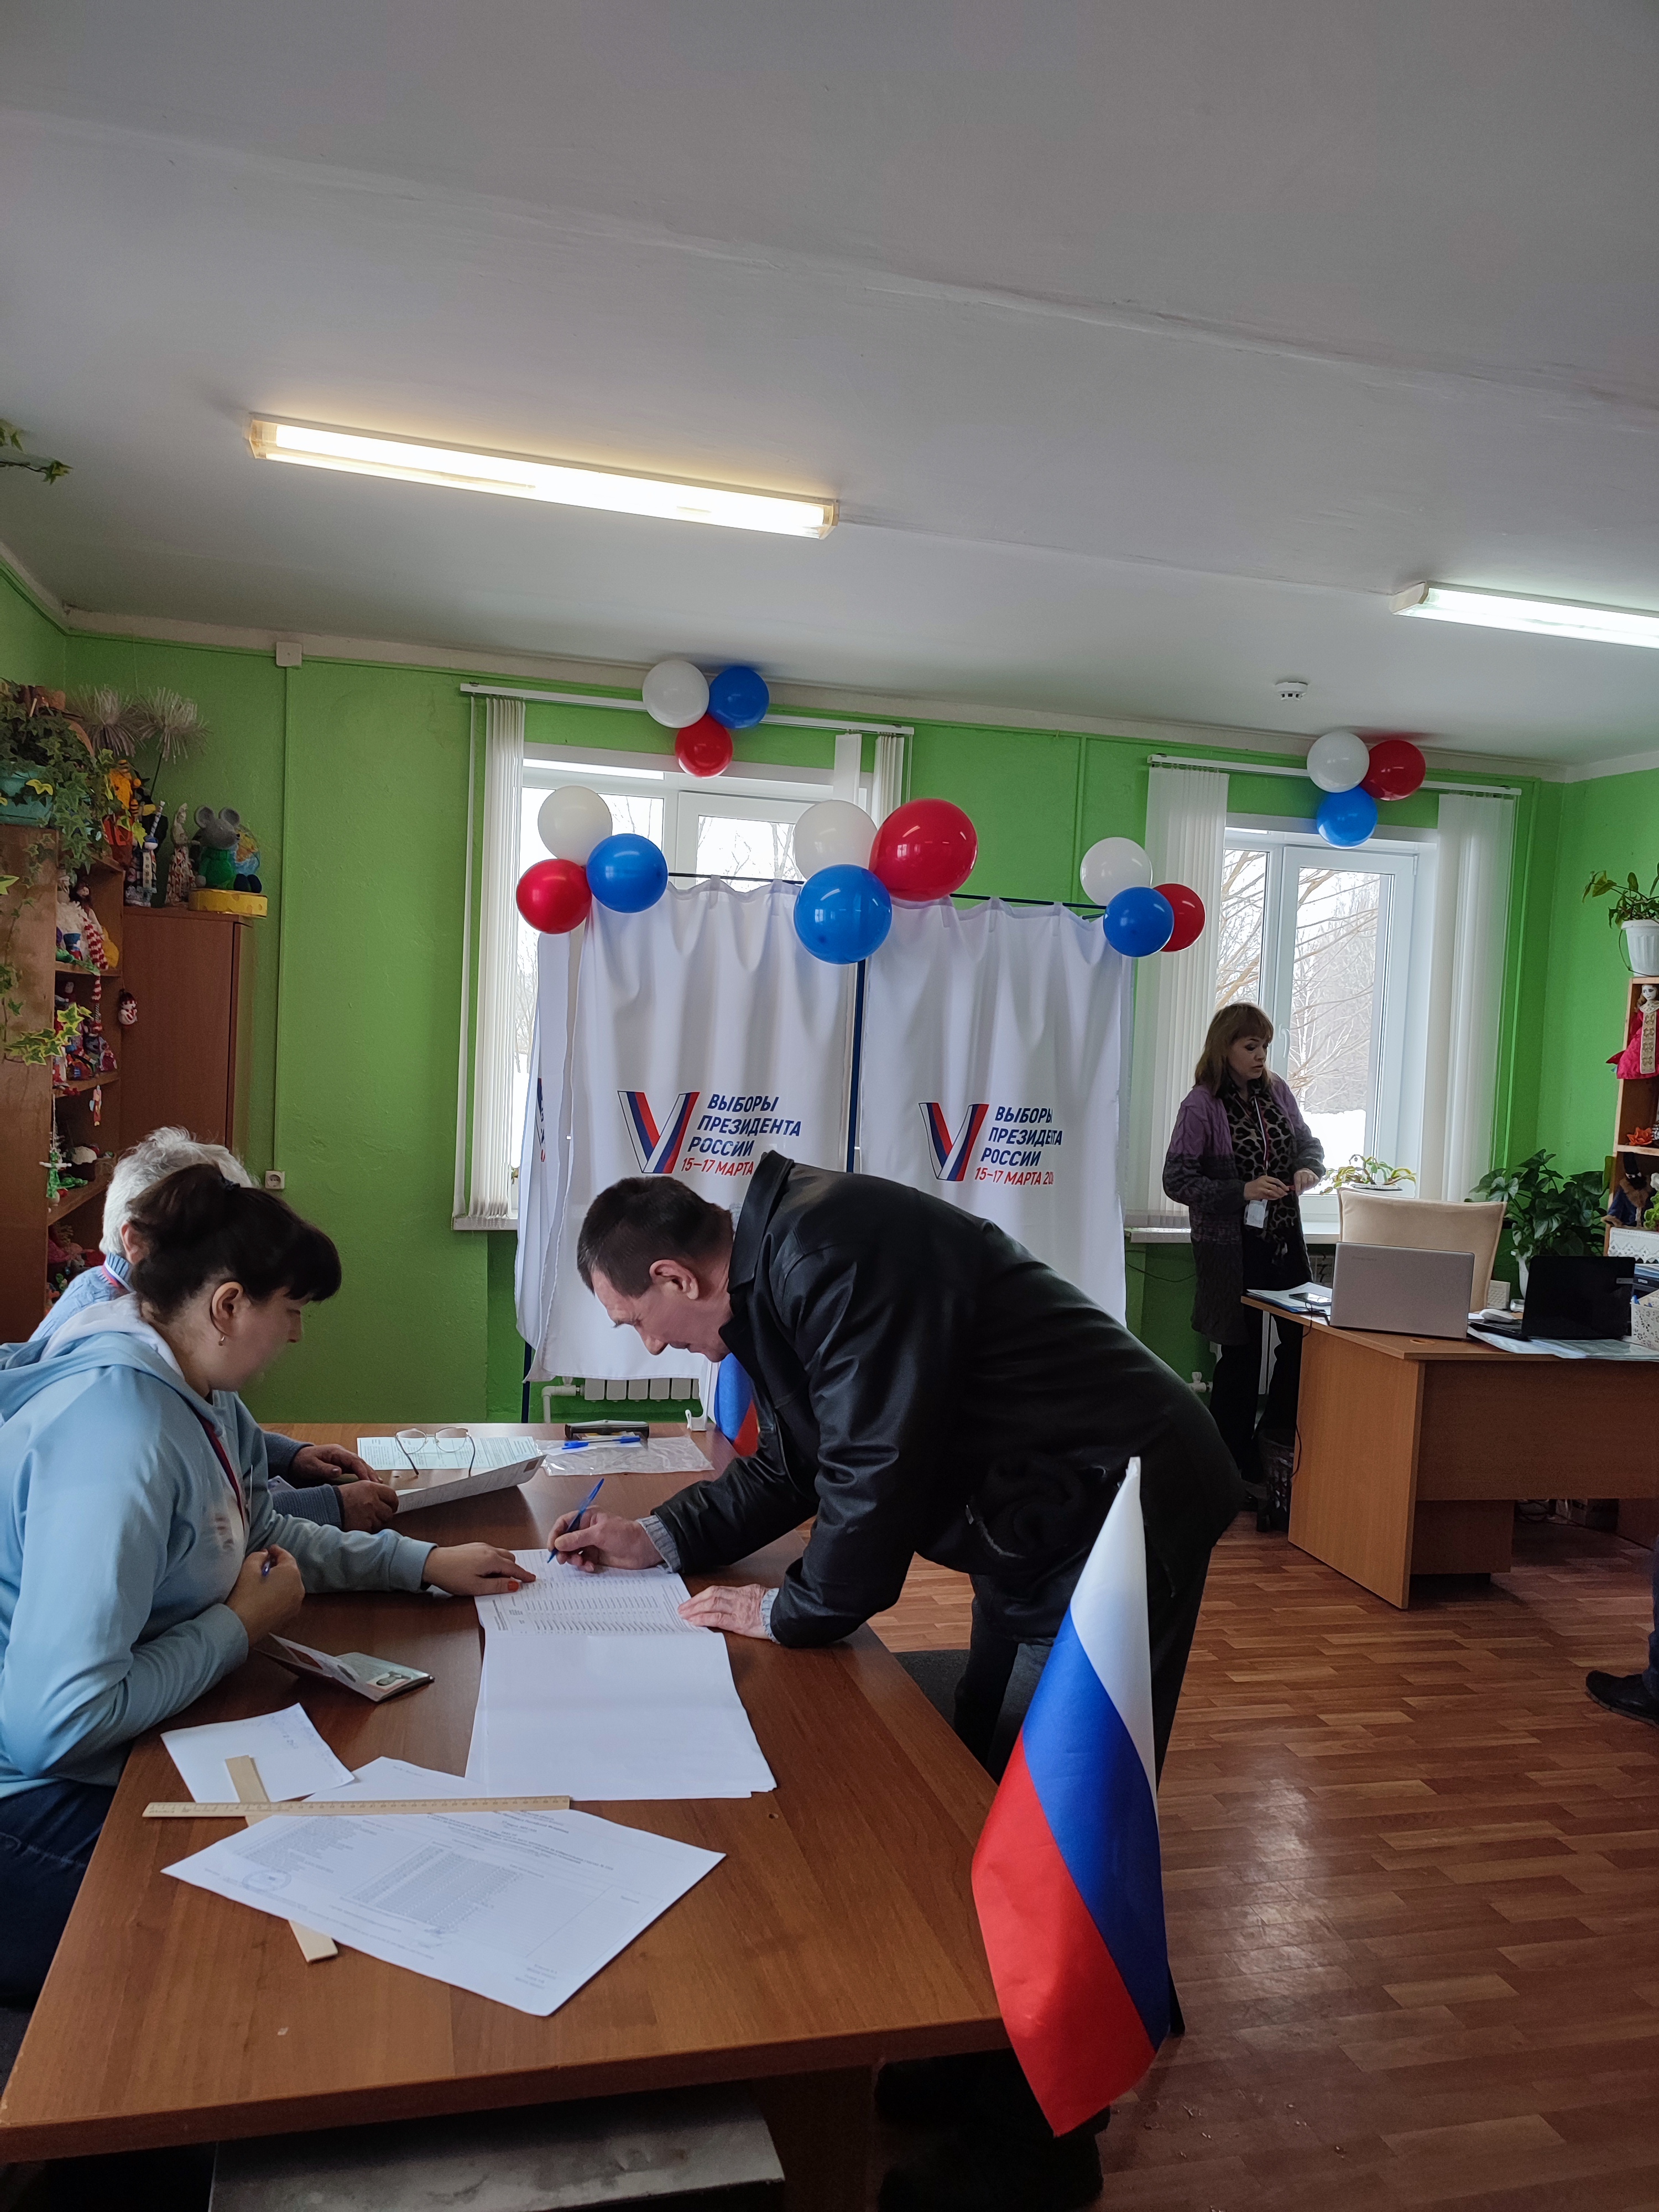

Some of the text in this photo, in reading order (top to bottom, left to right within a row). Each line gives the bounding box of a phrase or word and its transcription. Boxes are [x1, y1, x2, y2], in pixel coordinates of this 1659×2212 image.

[707, 1094, 779, 1112] ВЫБОРЫ
[697, 1115, 801, 1136] ПРЕЗИДЕНТА
[687, 1136, 754, 1156] РОССИИ
[980, 1147, 1041, 1166] РОССИИ
[714, 1161, 754, 1176] МАРТА
[1004, 1171, 1041, 1185] МАРТА
